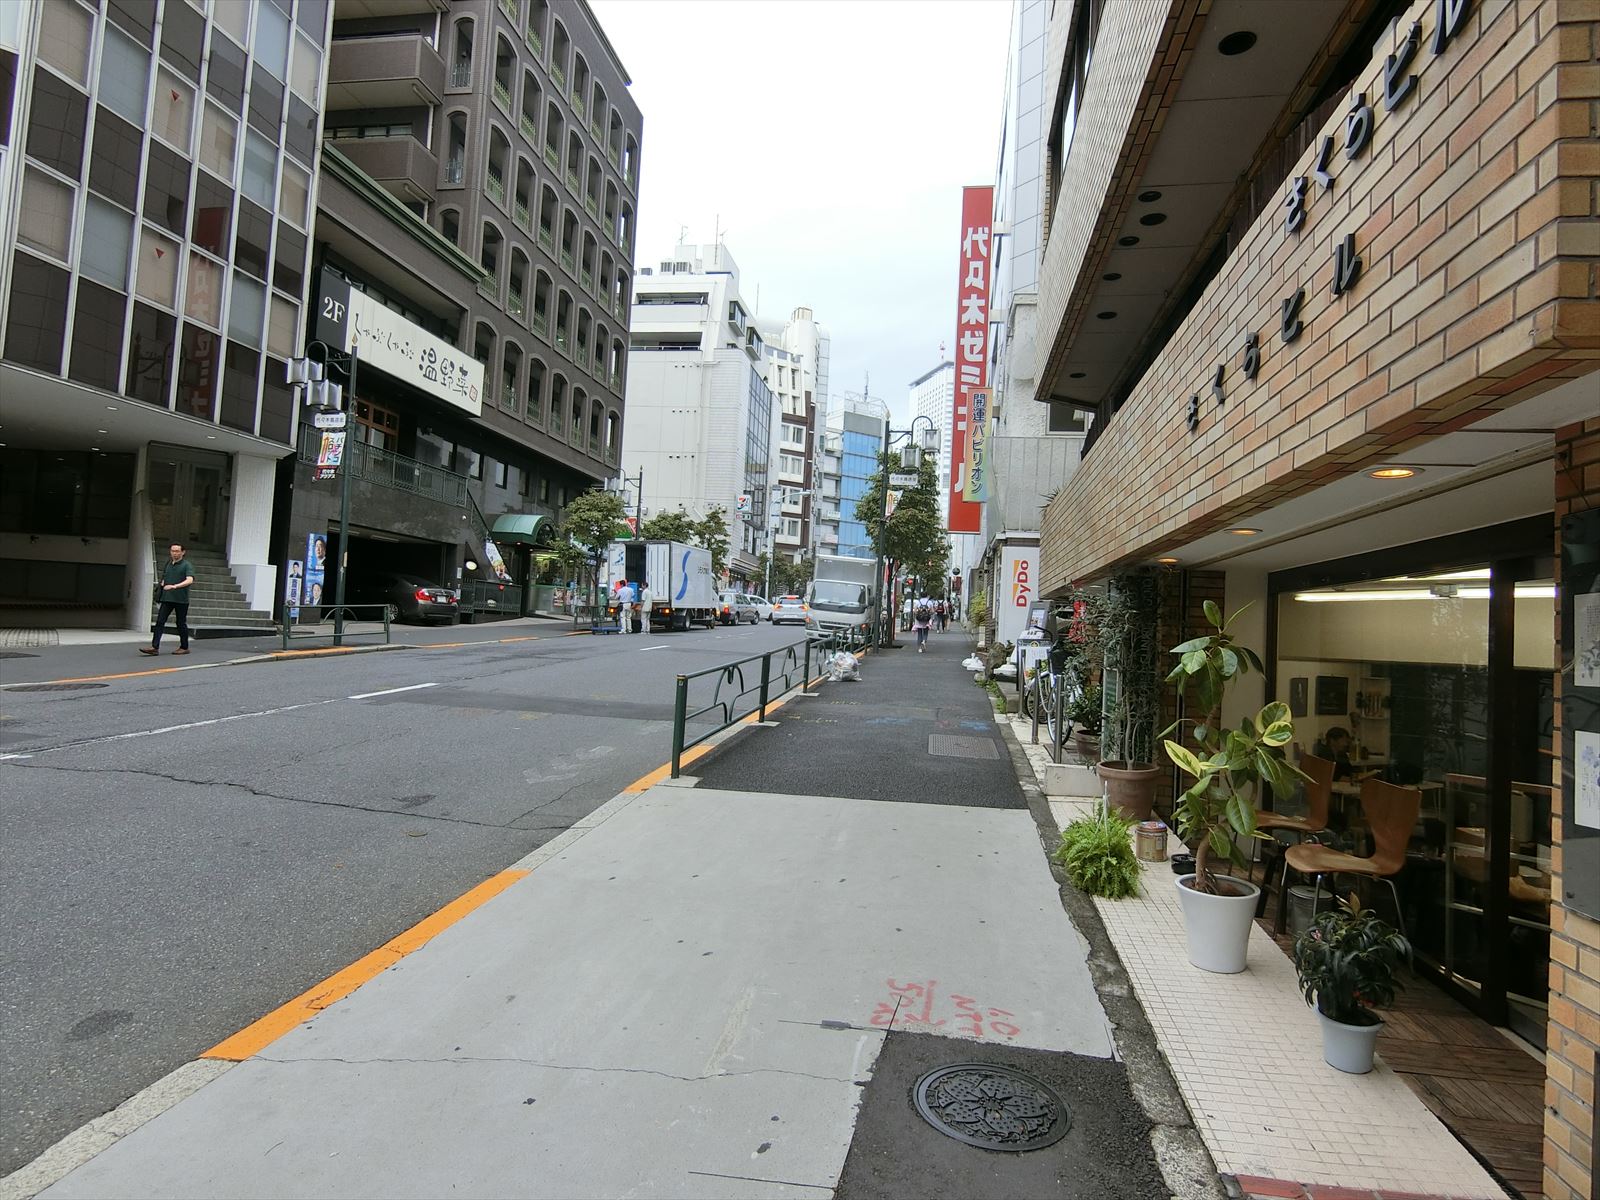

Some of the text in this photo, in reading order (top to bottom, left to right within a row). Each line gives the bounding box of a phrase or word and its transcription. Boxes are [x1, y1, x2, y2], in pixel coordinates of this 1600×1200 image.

[322, 296, 346, 323] 2F
[354, 313, 469, 397] しゃぶしゃぶ 温野菜
[955, 226, 990, 493] 代々木ゼミ
[332, 436, 344, 463] パチンコ
[970, 393, 987, 494] 開運パビリオン
[1015, 560, 1031, 607] DyDo
